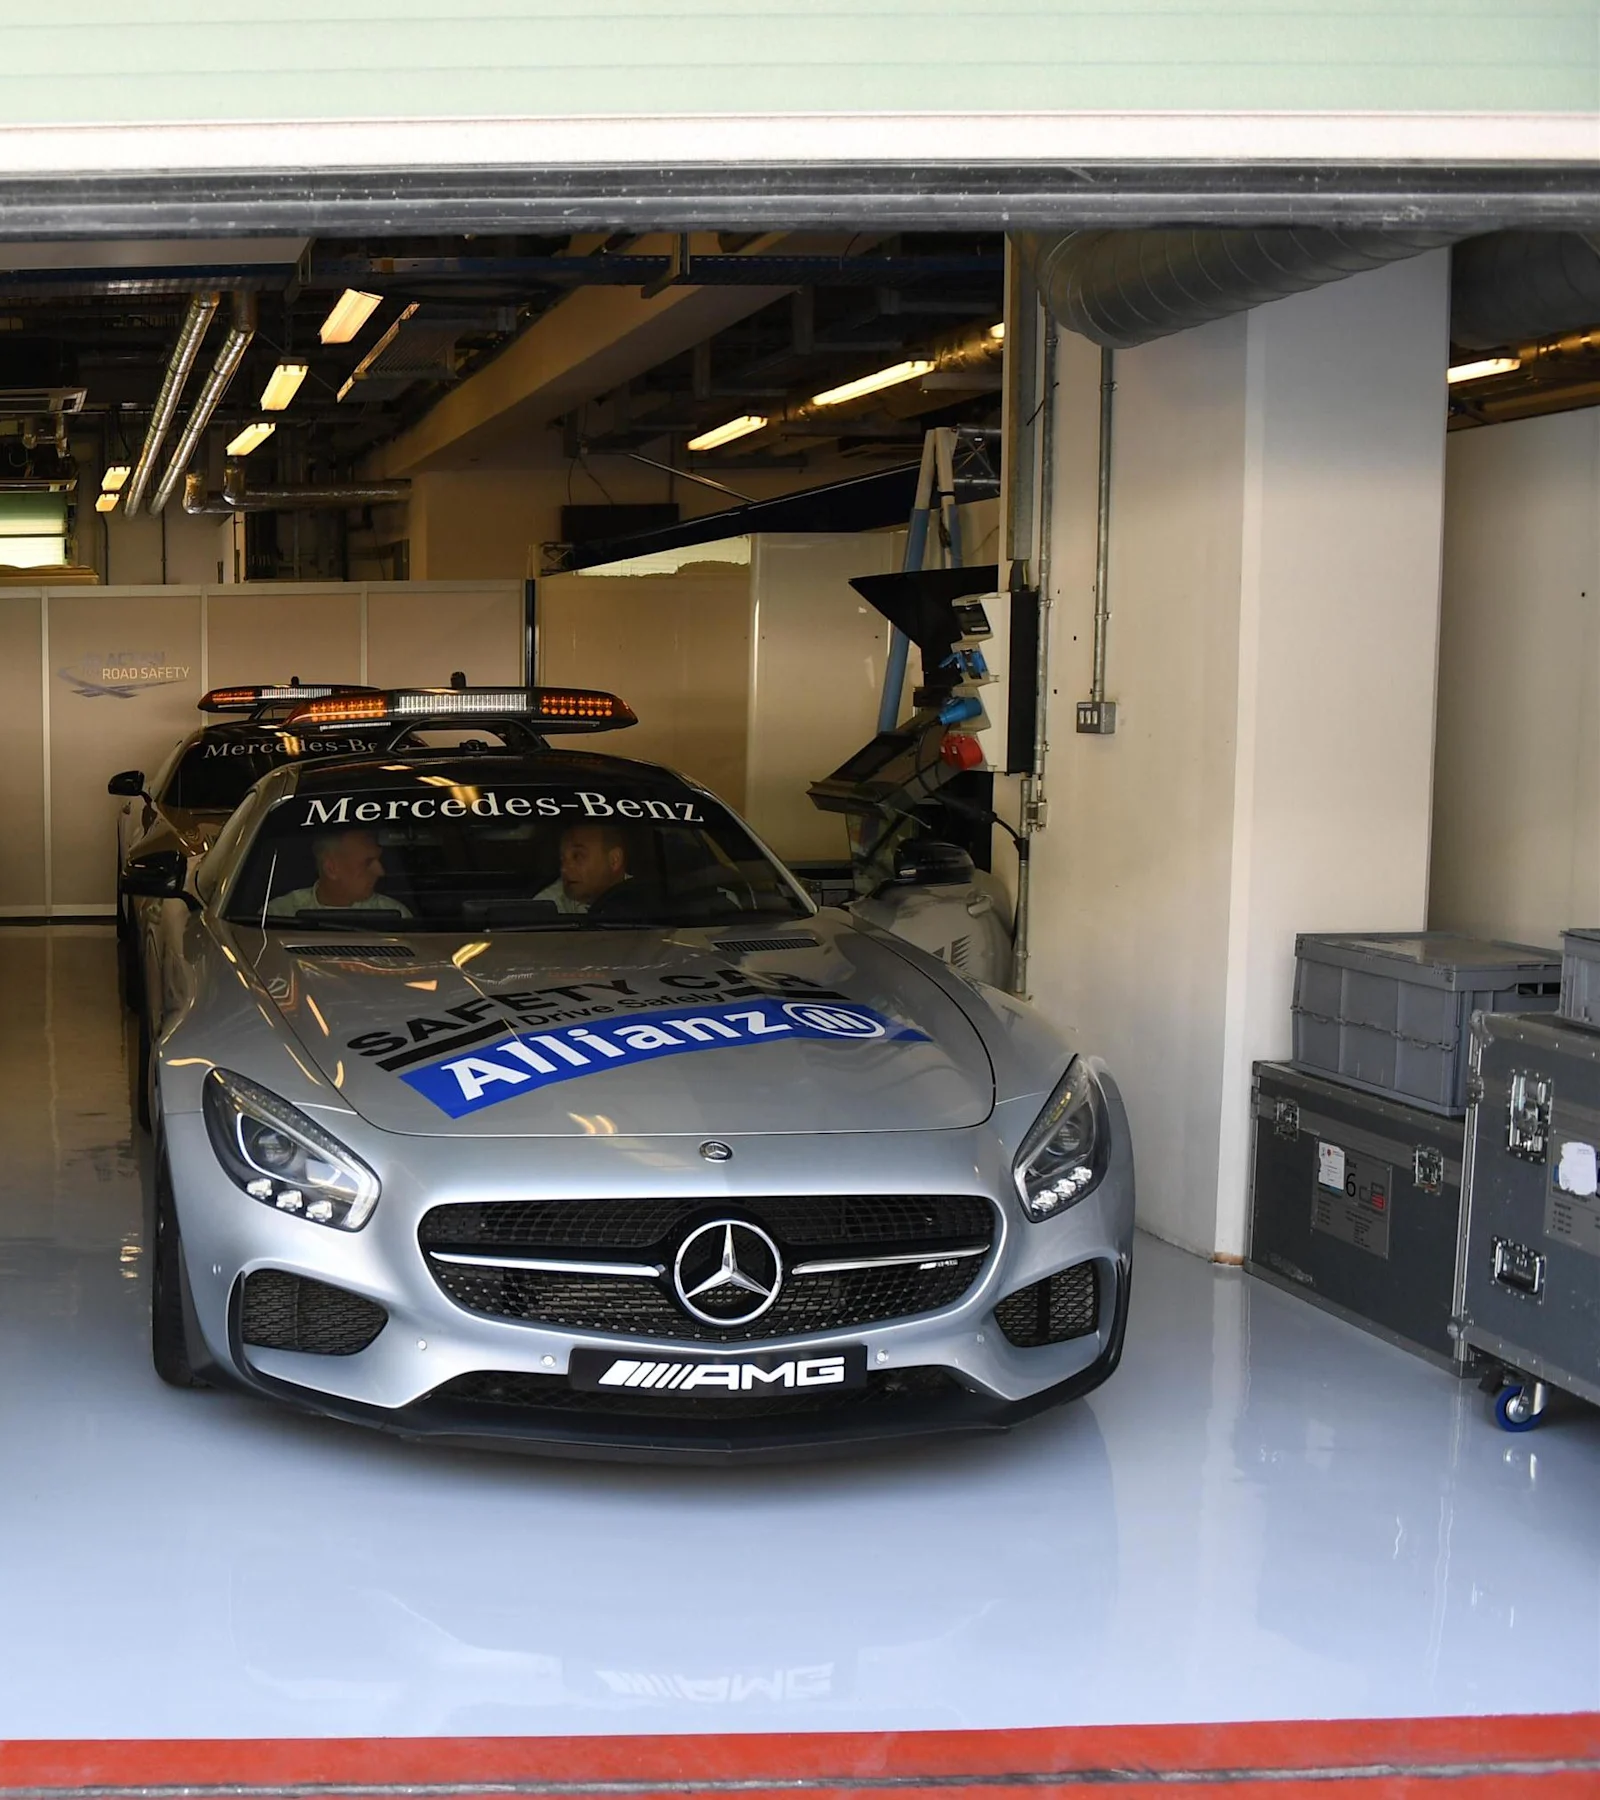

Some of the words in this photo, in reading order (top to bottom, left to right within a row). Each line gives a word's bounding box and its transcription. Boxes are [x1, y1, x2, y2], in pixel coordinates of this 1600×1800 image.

[102, 667, 138, 680] ROAD
[140, 666, 190, 679] SAFETY
[204, 739, 378, 758] Mercedes-Be
[300, 792, 705, 827] Mercedes-Benz
[347, 980, 639, 1058] SAFETY
[659, 969, 824, 990] CAR
[517, 1001, 616, 1026] Drive
[616, 991, 725, 1010] Safely
[441, 1010, 795, 1101] Allianz
[1345, 1172, 1357, 1197] 6
[679, 1356, 844, 1390] AMG
